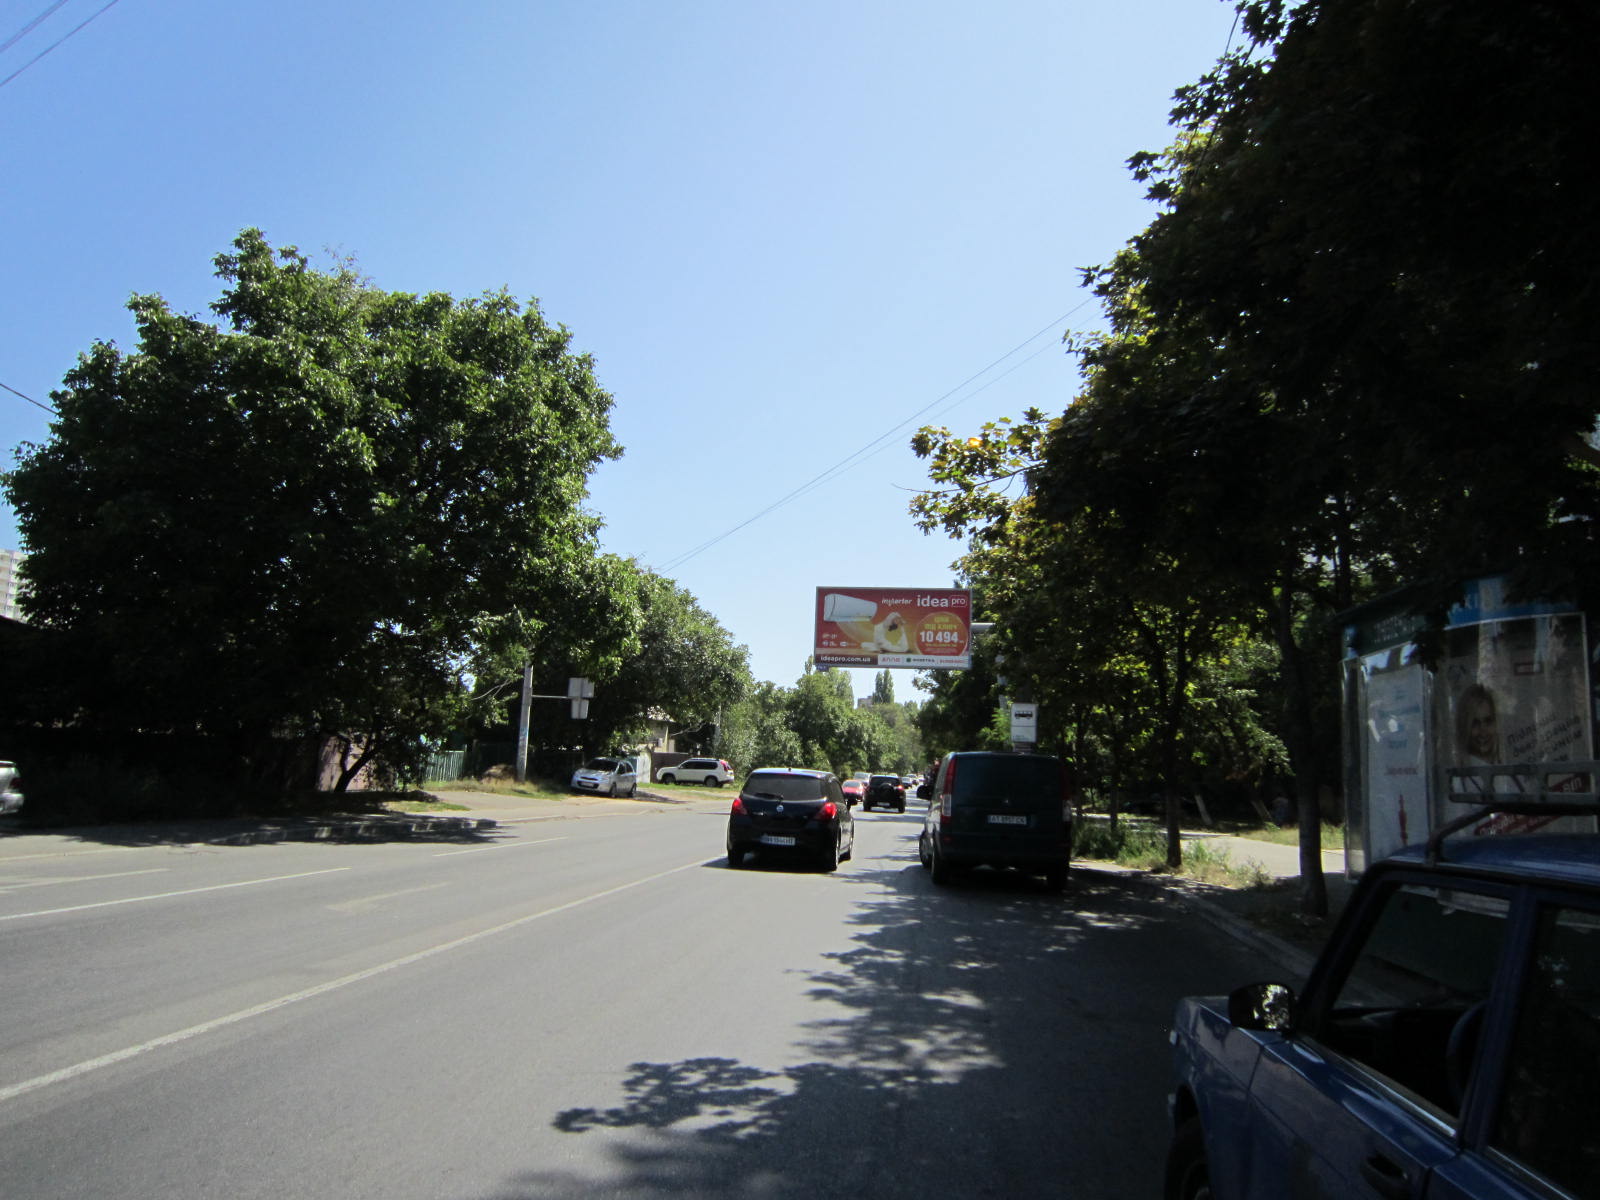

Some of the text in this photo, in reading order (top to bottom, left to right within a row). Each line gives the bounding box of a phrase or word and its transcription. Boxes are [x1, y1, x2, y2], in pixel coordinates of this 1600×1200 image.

[917, 594, 966, 608] idea pro
[820, 655, 871, 663] ideapro.com.ua
